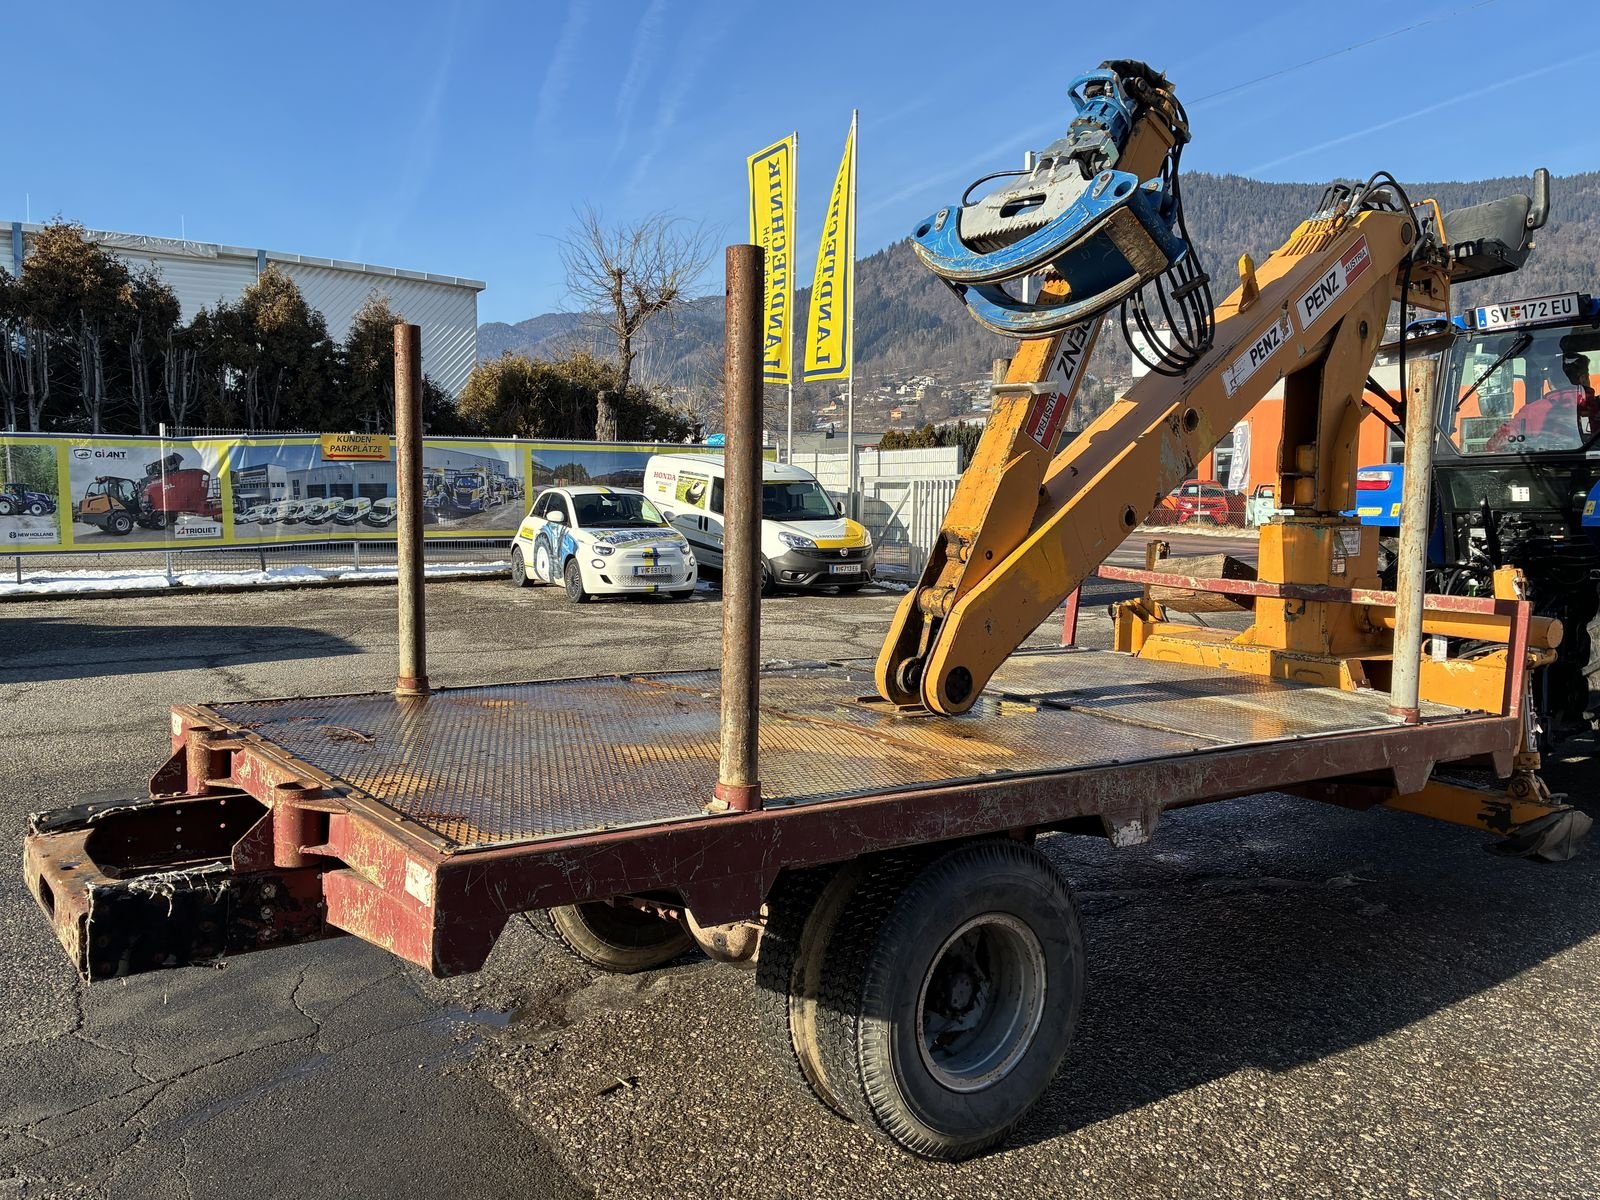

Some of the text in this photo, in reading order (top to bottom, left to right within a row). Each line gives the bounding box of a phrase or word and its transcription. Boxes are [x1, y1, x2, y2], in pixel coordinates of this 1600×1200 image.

[1345, 249, 1367, 274] AUSTRIA
[1304, 272, 1340, 317] PENZ
[1491, 306, 1509, 324] SV
[1521, 302, 1548, 319] 172
[1552, 298, 1572, 315] EU
[1249, 327, 1281, 367] PENZ
[1033, 391, 1057, 437] AUSTRIA
[330, 443, 383, 453] PARKPLÄTZE
[336, 435, 376, 443] KUNDEN-
[1234, 427, 1244, 465] AIXAM
[653, 471, 676, 481] HONDA
[185, 526, 217, 535] TRIOLIET
